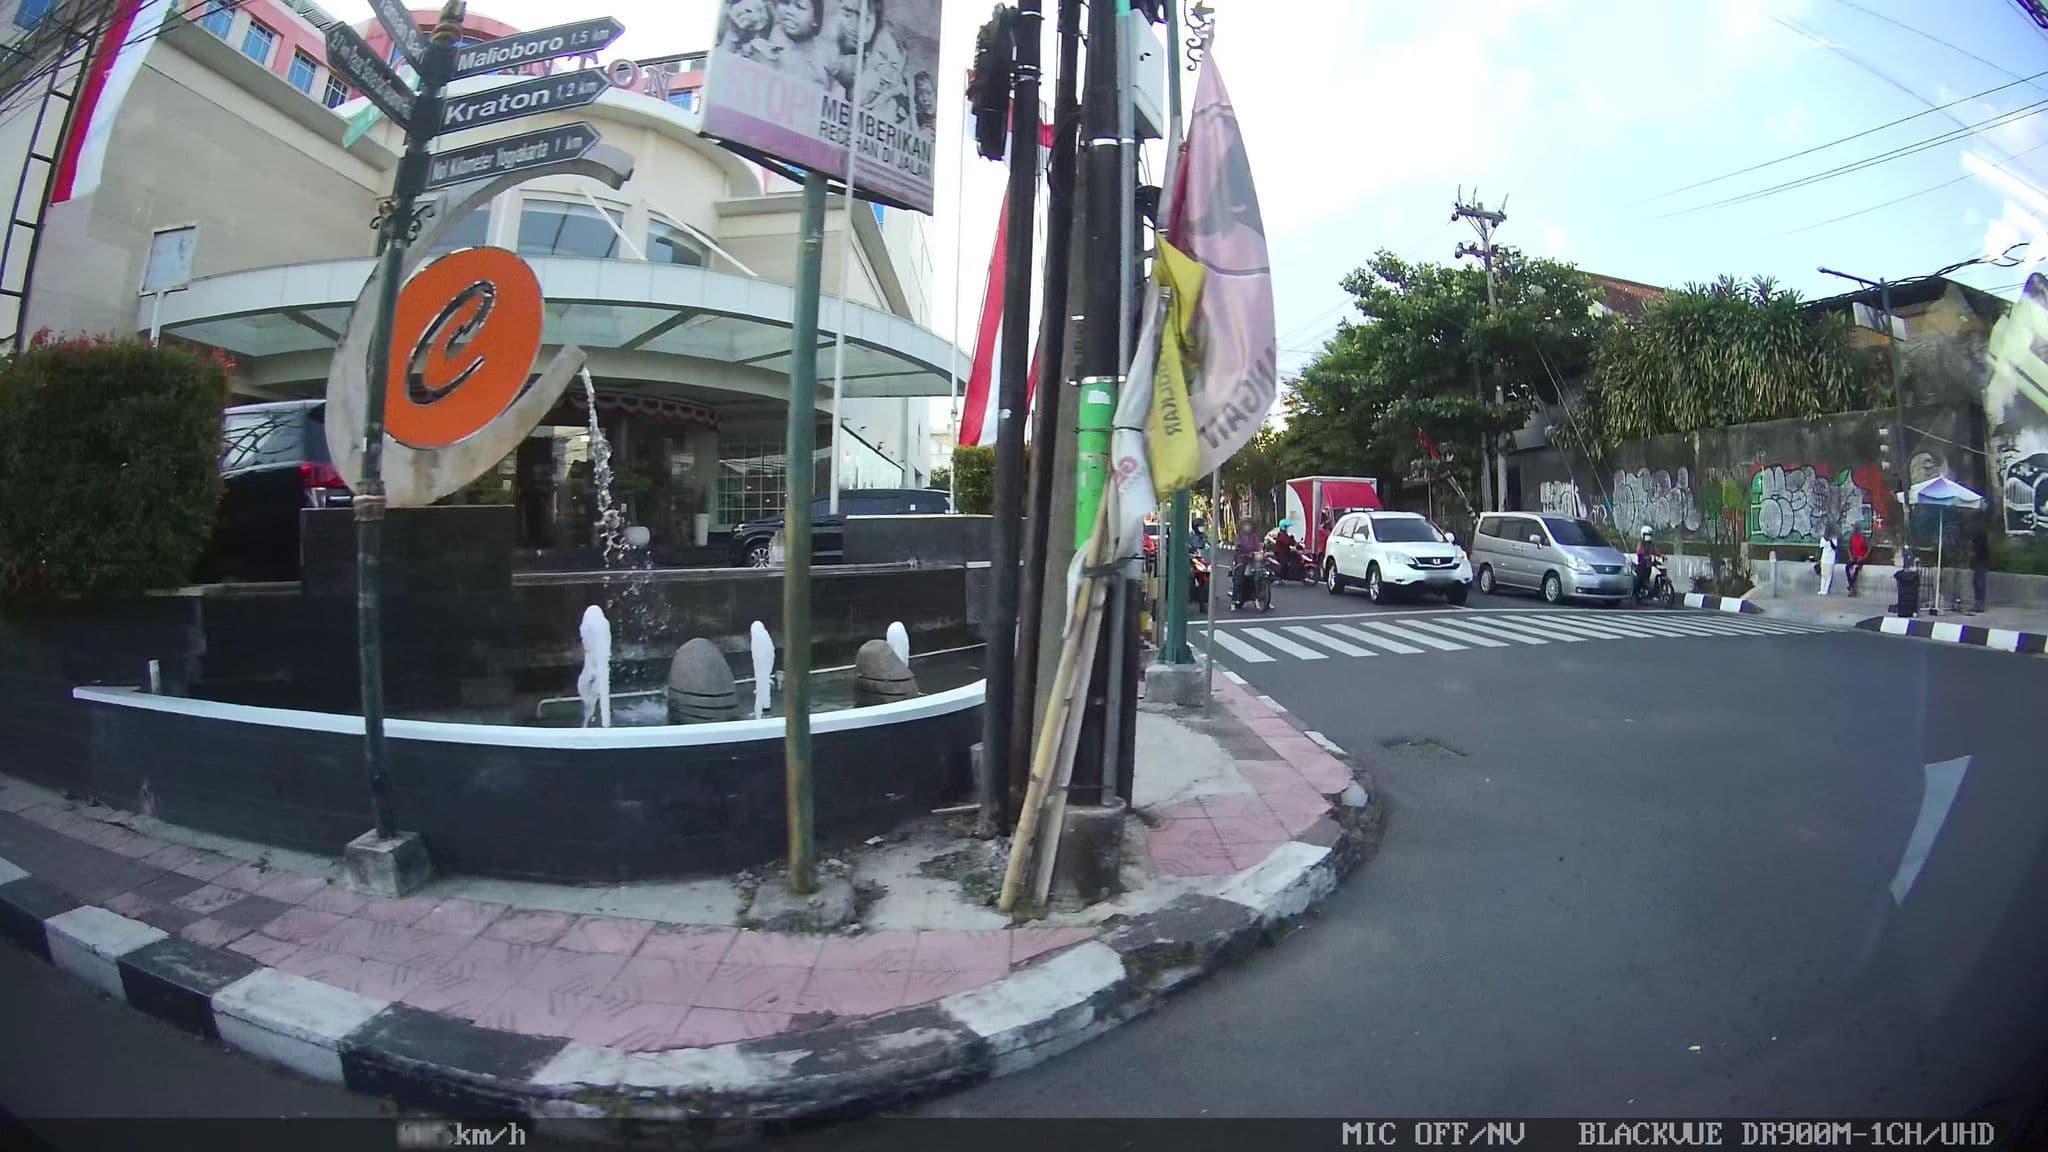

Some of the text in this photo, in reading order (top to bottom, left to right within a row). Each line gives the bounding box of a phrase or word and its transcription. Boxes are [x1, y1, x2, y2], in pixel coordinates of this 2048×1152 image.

[457, 36, 563, 72] Malioboro
[592, 29, 610, 42] km
[444, 88, 550, 125] Kraton
[577, 81, 599, 95] km
[554, 138, 561, 152] 1
[566, 135, 583, 150] km
